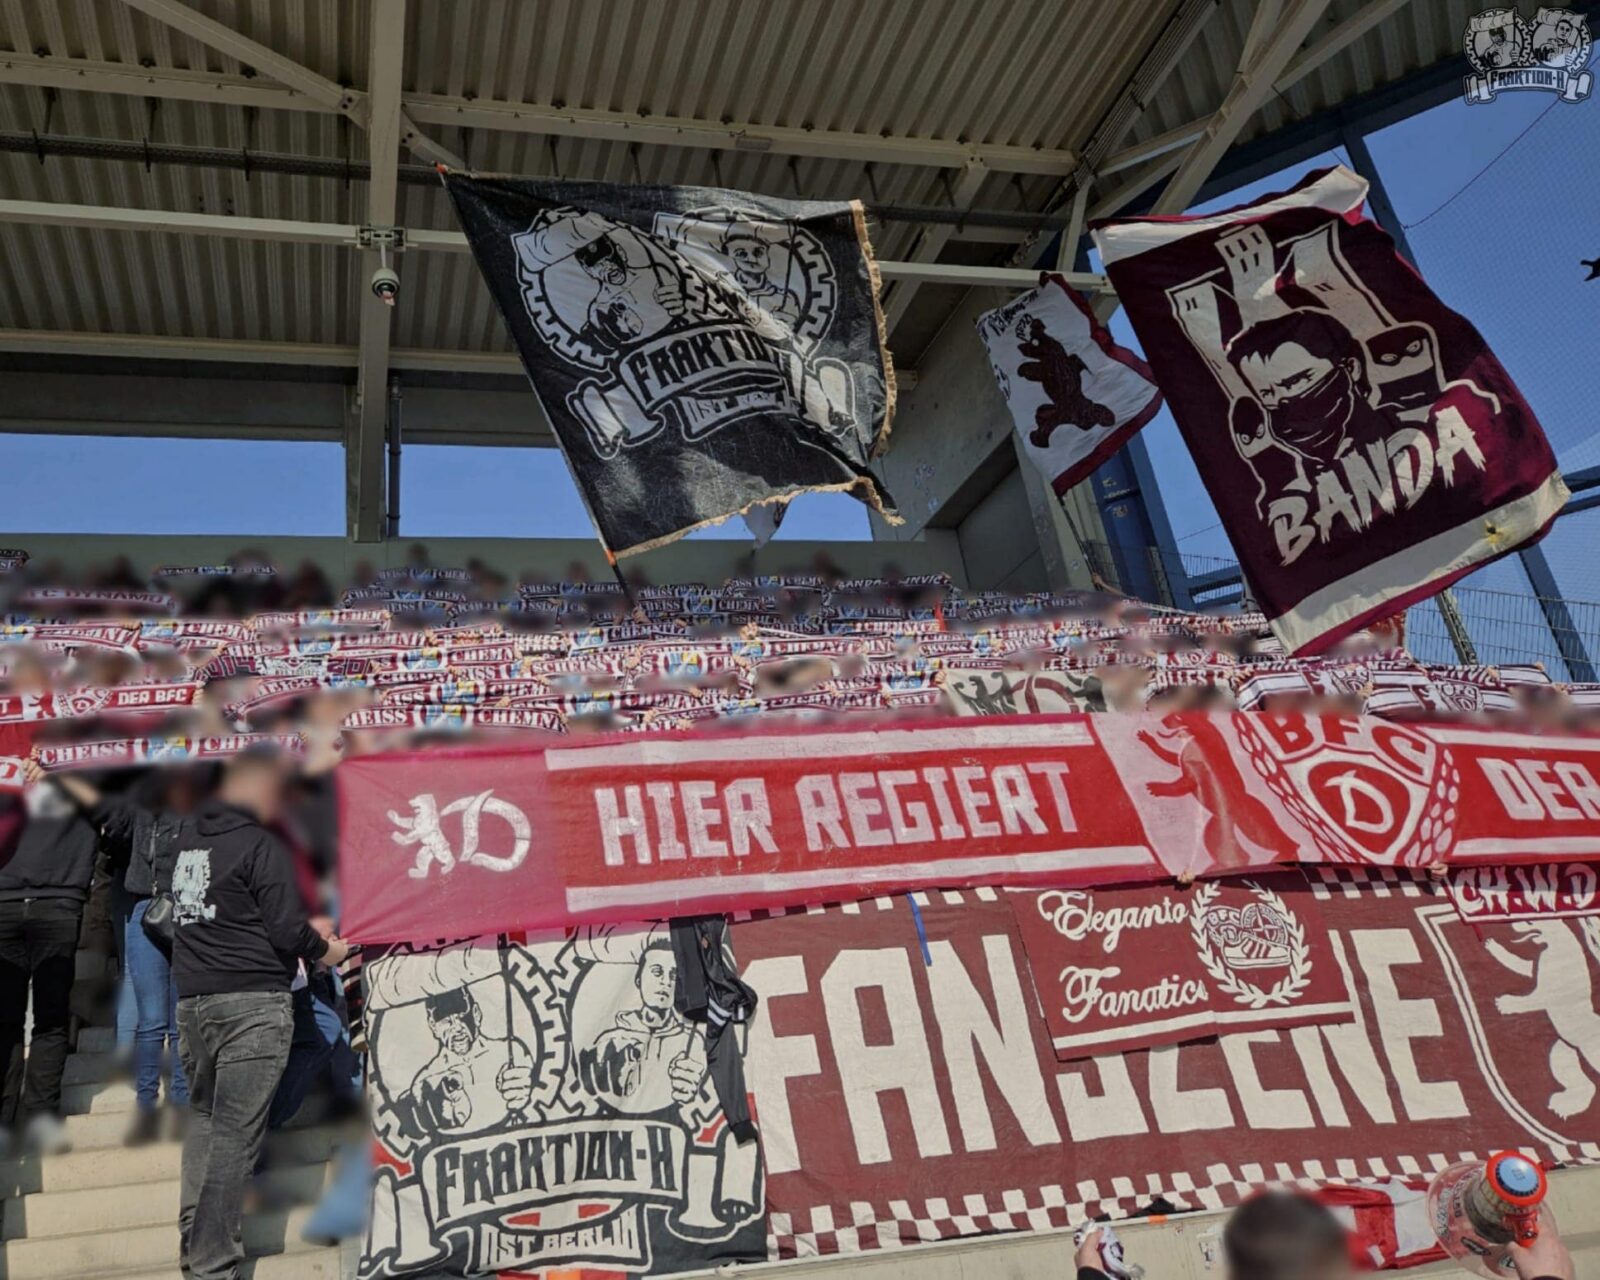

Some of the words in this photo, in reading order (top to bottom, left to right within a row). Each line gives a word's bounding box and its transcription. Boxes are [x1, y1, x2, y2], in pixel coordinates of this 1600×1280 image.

[1266, 406, 1488, 567] BANDA
[117, 690, 150, 706] DER
[154, 687, 188, 703] BFC
[593, 776, 782, 867] HIER
[795, 761, 1079, 853] REGIERT
[1059, 965, 1209, 1023] Fanatics
[433, 1122, 677, 1221] FRAKTION-H
[477, 1222, 537, 1271] OST
[543, 1203, 642, 1259] BERLIN
